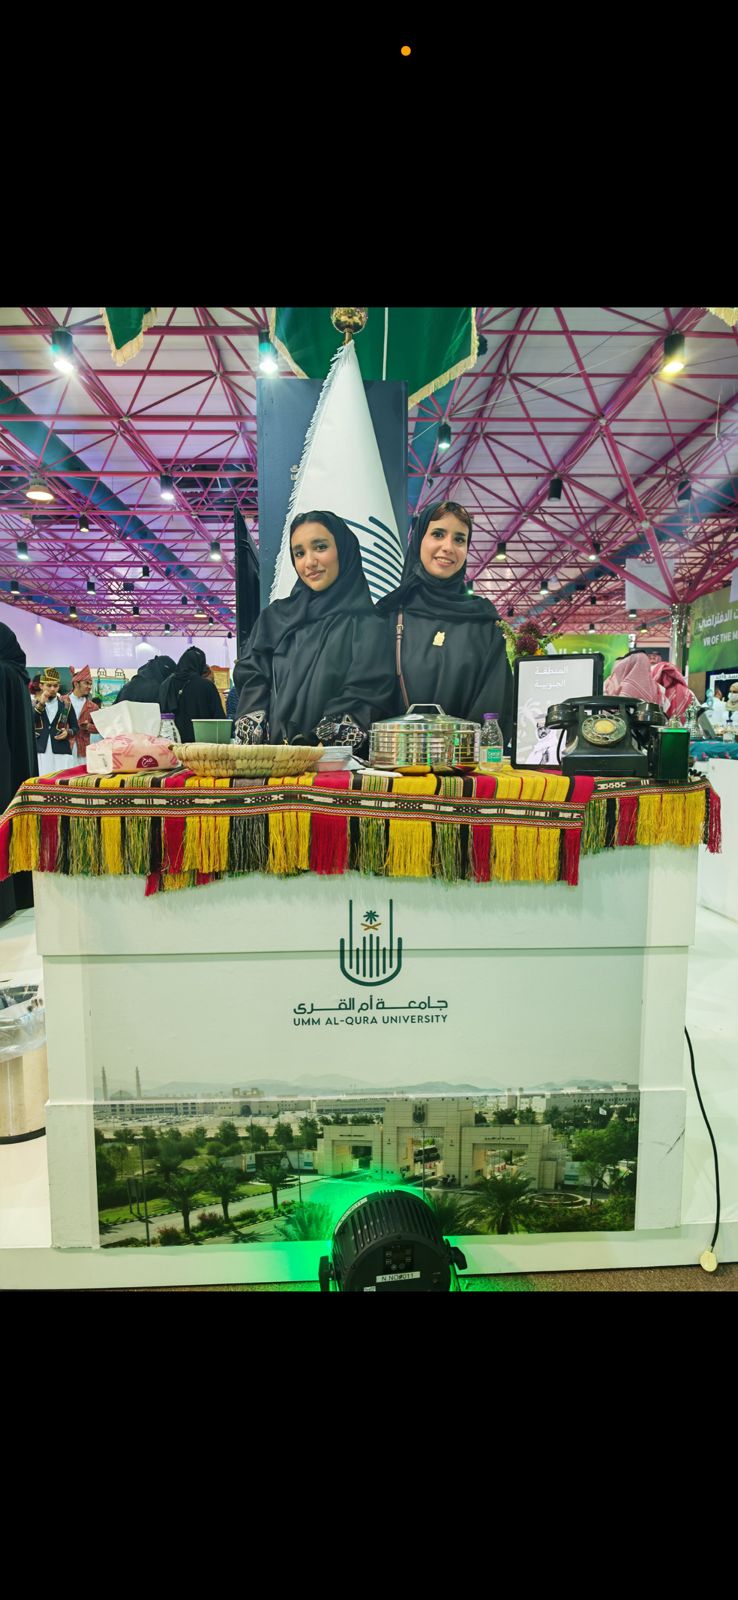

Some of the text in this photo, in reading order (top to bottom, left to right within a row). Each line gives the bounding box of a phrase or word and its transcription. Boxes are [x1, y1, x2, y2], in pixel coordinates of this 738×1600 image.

[711, 635, 719, 645] OF
[720, 632, 731, 643] THE
[293, 995, 448, 1014] جامعة أم القرى
[293, 1014, 448, 1026] UMM AL-QURA UNIVERSITY
